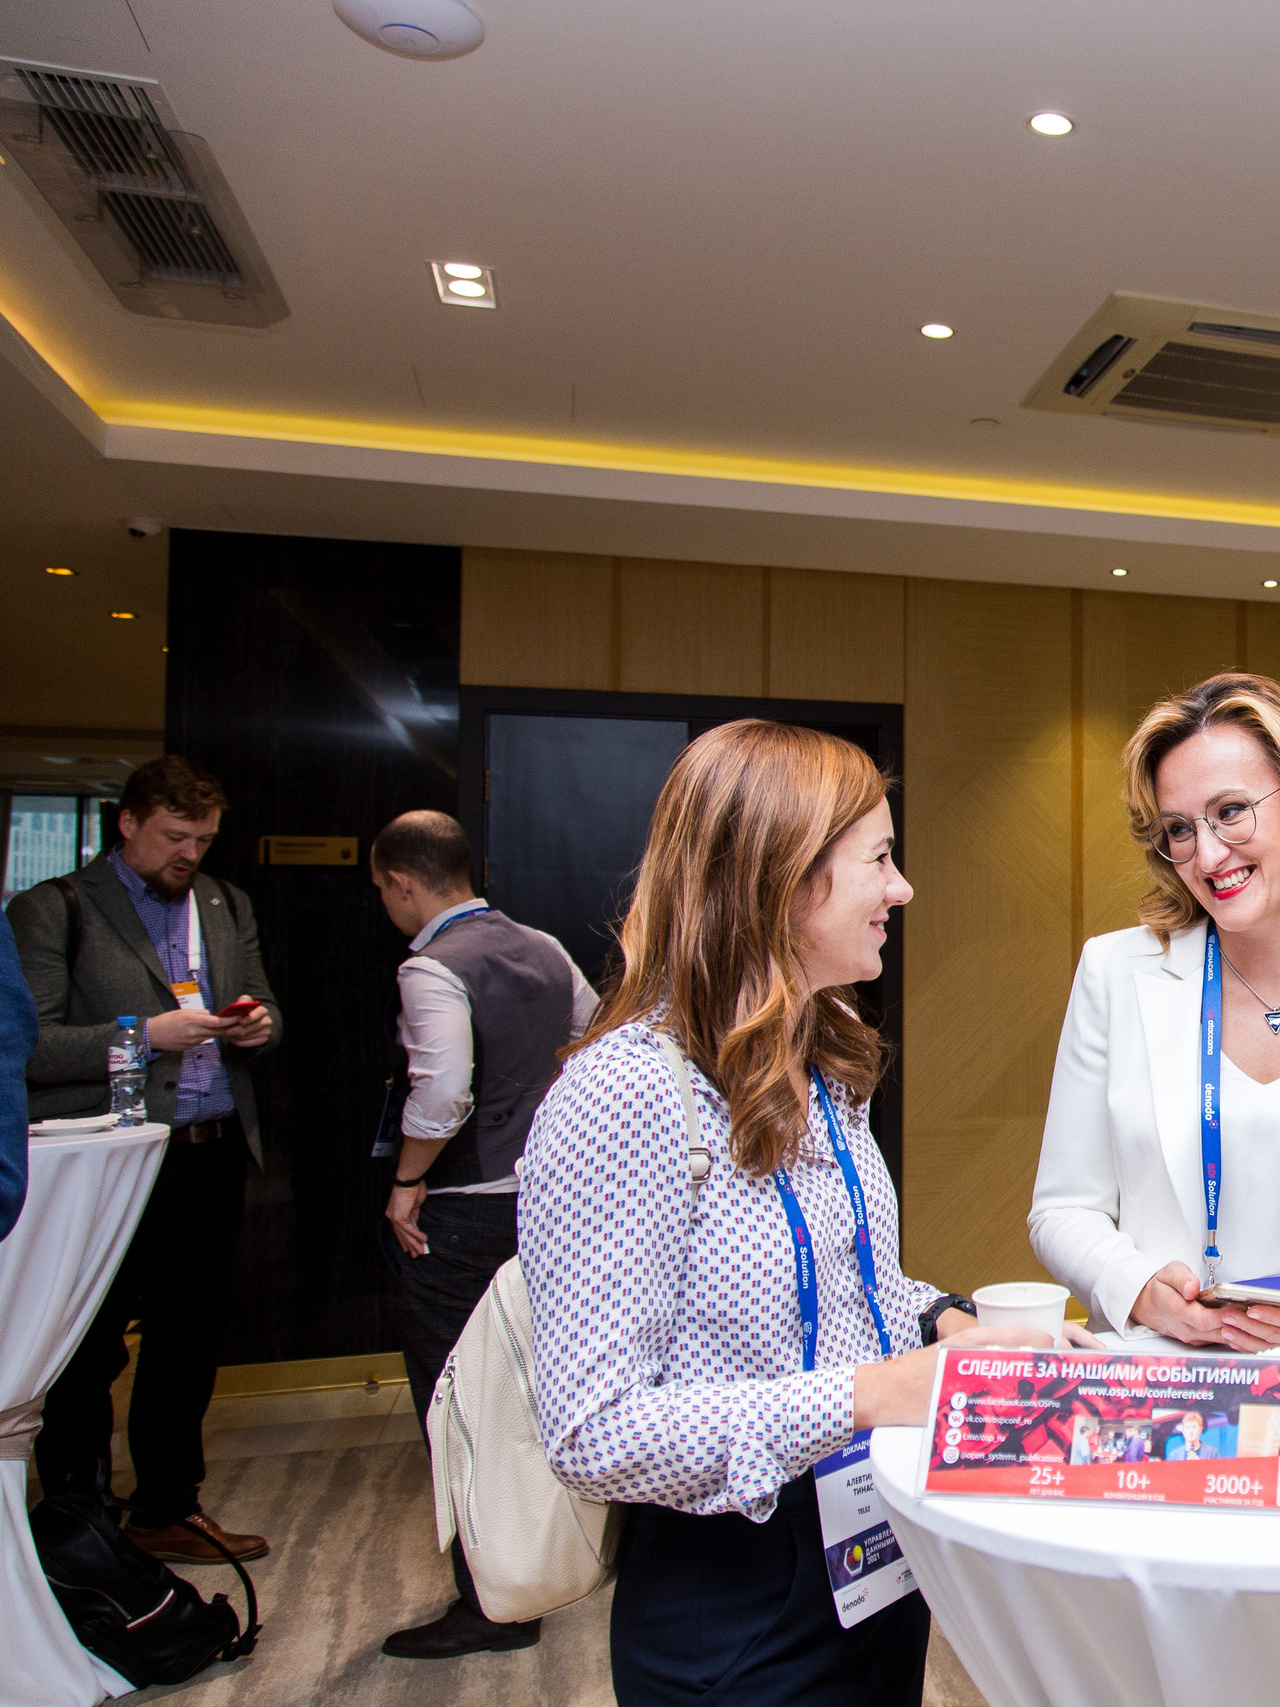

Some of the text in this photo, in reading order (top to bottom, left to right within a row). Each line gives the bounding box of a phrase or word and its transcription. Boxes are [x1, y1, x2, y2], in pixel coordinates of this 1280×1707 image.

[1205, 1083, 1213, 1121] denodo
[824, 1095, 844, 1142] ARENADATA
[1208, 1163, 1216, 1217] SDI Solution
[853, 1185, 867, 1245] SDI Solution
[795, 1226, 809, 1290] SDI Solution
[957, 1358, 1260, 1386] СЛЕДИТЕ ЗА НАШИМИ СОБЫТИЯМИ
[1078, 1385, 1215, 1400] www.osp.ru/conferences
[842, 1439, 870, 1458] ДОКЛАДЧ
[846, 1473, 873, 1487] АЛЕВТИ
[1029, 1465, 1066, 1486] 25+
[1117, 1470, 1151, 1490] 10+
[1204, 1474, 1263, 1495] 3000+
[864, 1529, 893, 1547] УПРАВЛЕН
[865, 1536, 896, 1557] ДАННЫМИ
[867, 1553, 880, 1565] 2021
[842, 1594, 866, 1613] denodo
